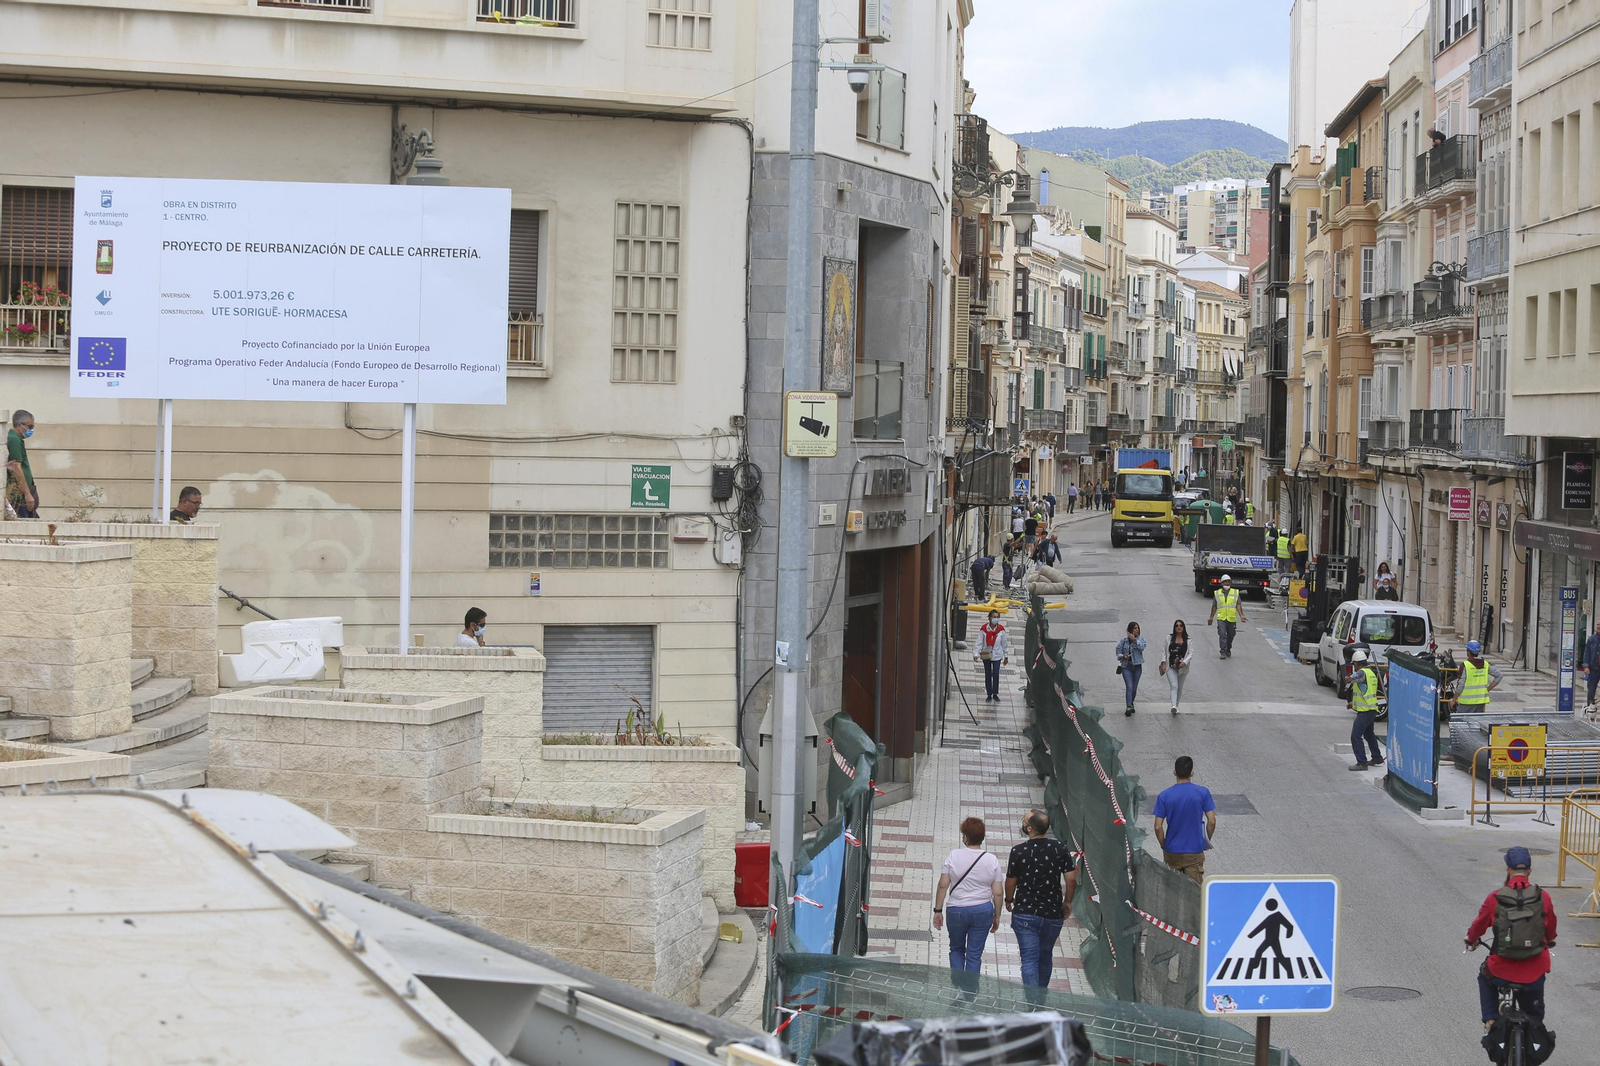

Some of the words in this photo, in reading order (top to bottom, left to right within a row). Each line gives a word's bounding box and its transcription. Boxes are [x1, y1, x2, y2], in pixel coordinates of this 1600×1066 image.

[84, 210, 129, 218] Ayuntamiento
[163, 241, 222, 252] PROYECTO
[226, 242, 241, 252] DE
[245, 242, 346, 255] REURBANIZACIÓN
[350, 246, 365, 255] DE
[368, 246, 404, 256] CALLE
[408, 247, 481, 259] CARRETERÍA.
[213, 290, 284, 300] 5.001.973,26
[287, 292, 295, 300] €
[212, 307, 230, 316] UTE
[284, 309, 347, 318] HORMACESA
[242, 340, 279, 350] Proyecto
[282, 340, 338, 350] Cofinanciado
[341, 344, 355, 352] por
[357, 342, 365, 350] la
[368, 342, 392, 351] Unión
[395, 343, 430, 353] Europea
[169, 357, 212, 367] Programa
[215, 358, 256, 368] Operativo
[259, 359, 283, 367] Feder
[286, 359, 328, 368] Andalucía
[331, 360, 360, 370] (Fondo
[363, 361, 398, 371] Europeo
[401, 362, 412, 370] de
[414, 362, 457, 371] Desarrollo
[460, 363, 500, 373] Regional)
[272, 378, 289, 386] Una
[328, 379, 339, 387] de
[342, 380, 366, 388] hacer
[368, 380, 398, 389] Europa
[1564, 590, 1576, 599] BUS
